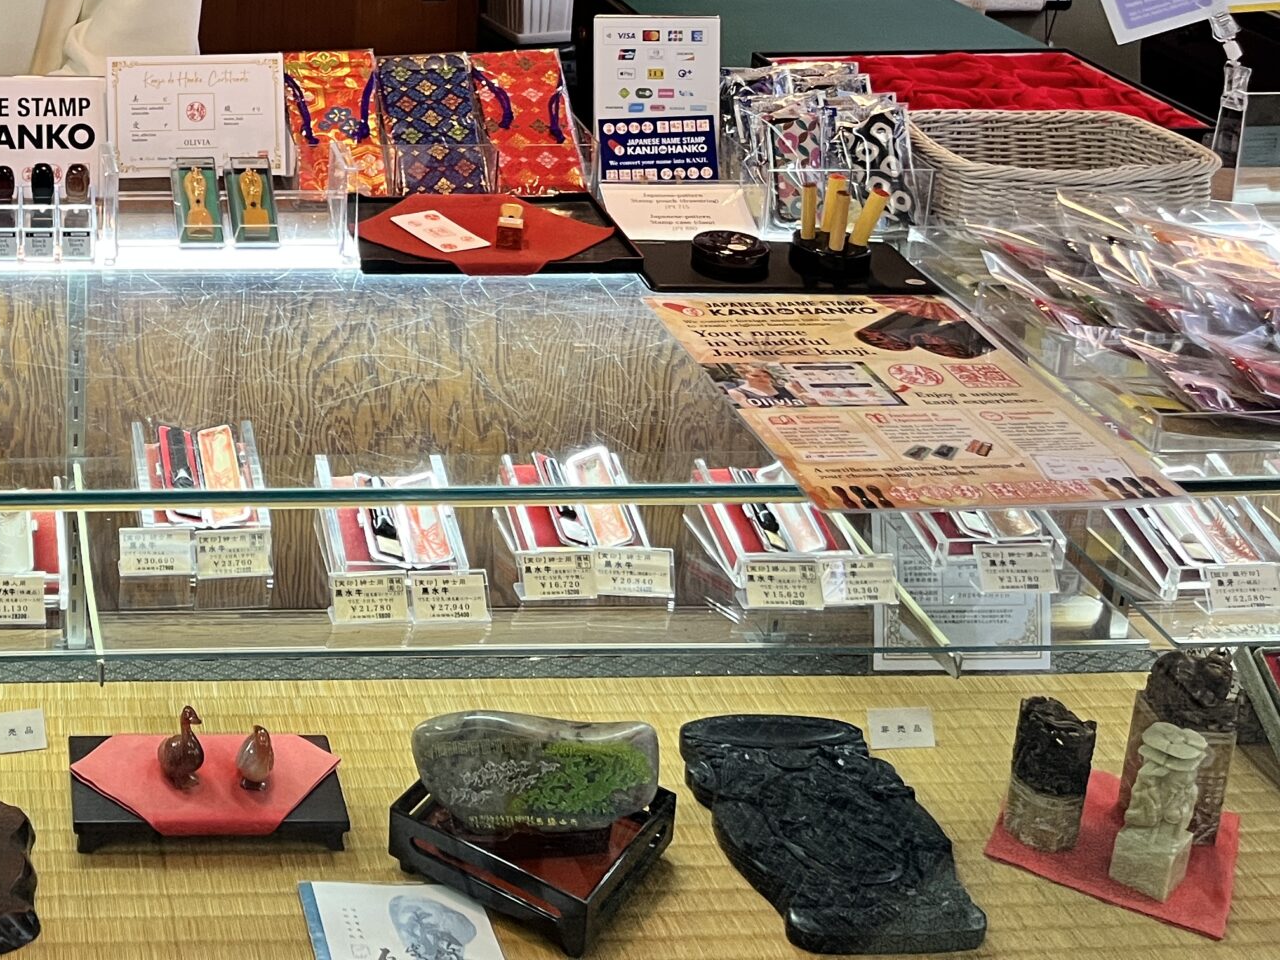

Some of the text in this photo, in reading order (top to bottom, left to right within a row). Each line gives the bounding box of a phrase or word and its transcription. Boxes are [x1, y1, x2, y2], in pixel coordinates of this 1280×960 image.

[17, 97, 91, 117] STAMP
[626, 136, 705, 146] JAPANESE NAME STAMP
[626, 146, 659, 155] KANJI
[667, 144, 707, 154] HANKO
[820, 299, 866, 307] STAMP
[710, 308, 777, 316] KANJI
[795, 306, 878, 316] HANKO
[694, 329, 808, 338] Your name
[707, 337, 831, 348] in beautiful
[712, 347, 878, 358] Japanese kanji.
[746, 397, 805, 408] Olivia
[524, 566, 552, 574] 黒水牛
[747, 574, 775, 582] 黒水牛
[540, 581, 580, 589] ¥16,720
[335, 589, 364, 597] 黒水牛
[421, 587, 449, 595] 黒水牛
[430, 603, 470, 611] ¥27,940
